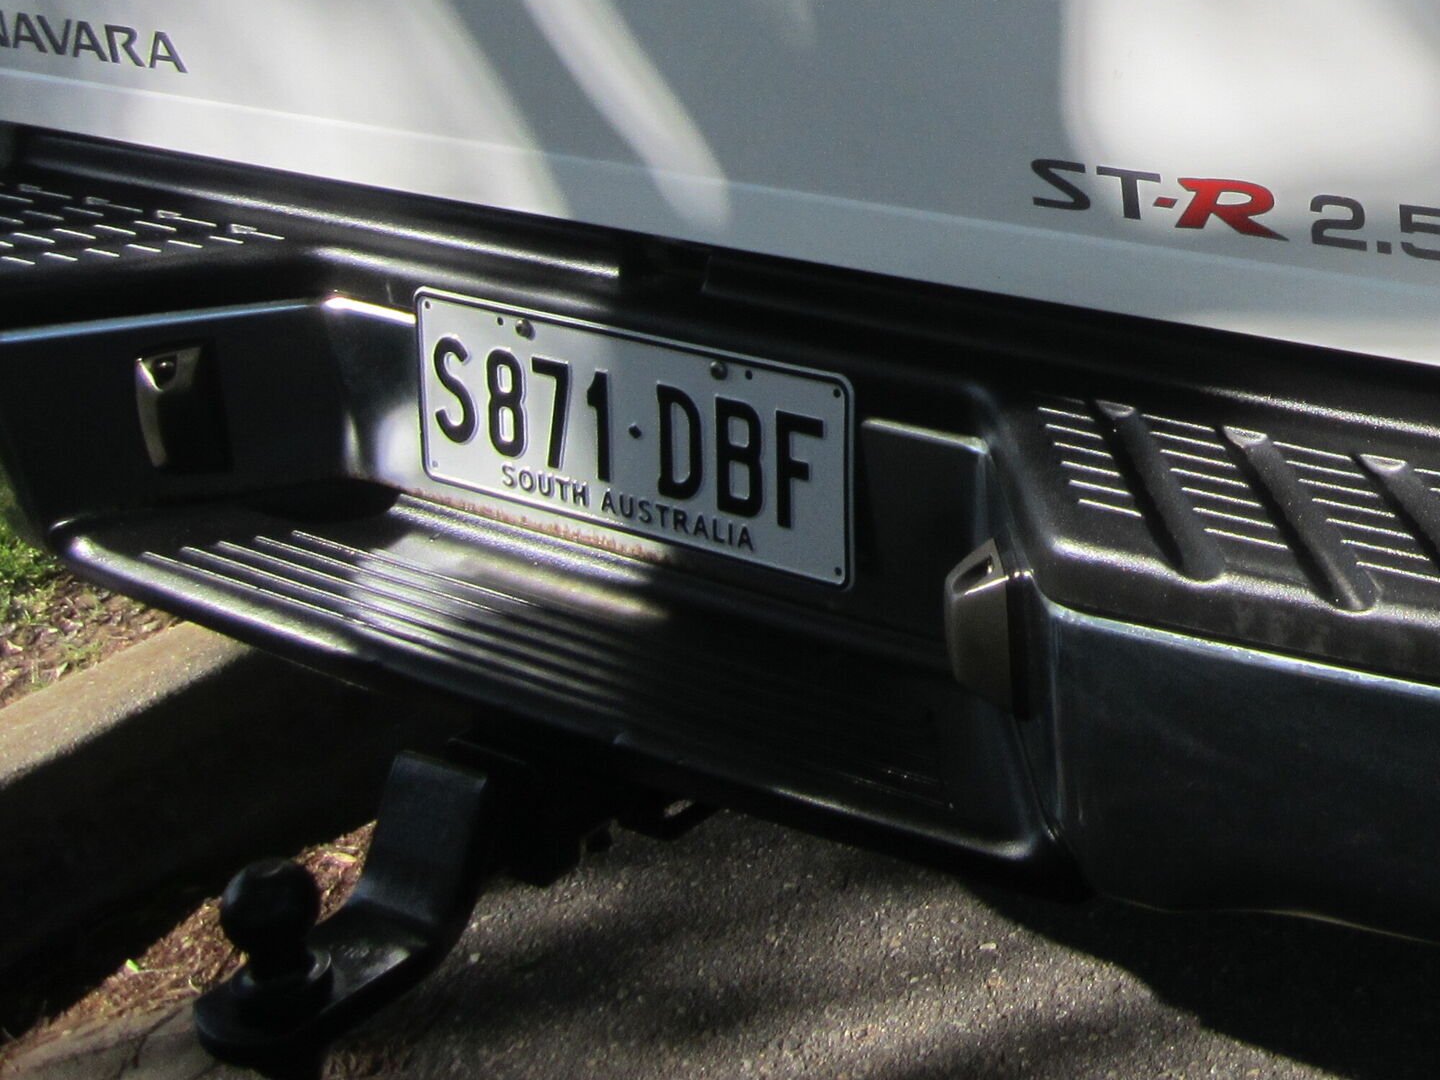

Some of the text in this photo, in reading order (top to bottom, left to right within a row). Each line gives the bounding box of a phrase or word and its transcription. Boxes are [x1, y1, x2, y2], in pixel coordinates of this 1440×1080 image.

[1030, 158, 1290, 242] ST-R
[501, 464, 755, 552] SOUTH AUSTRALIA
